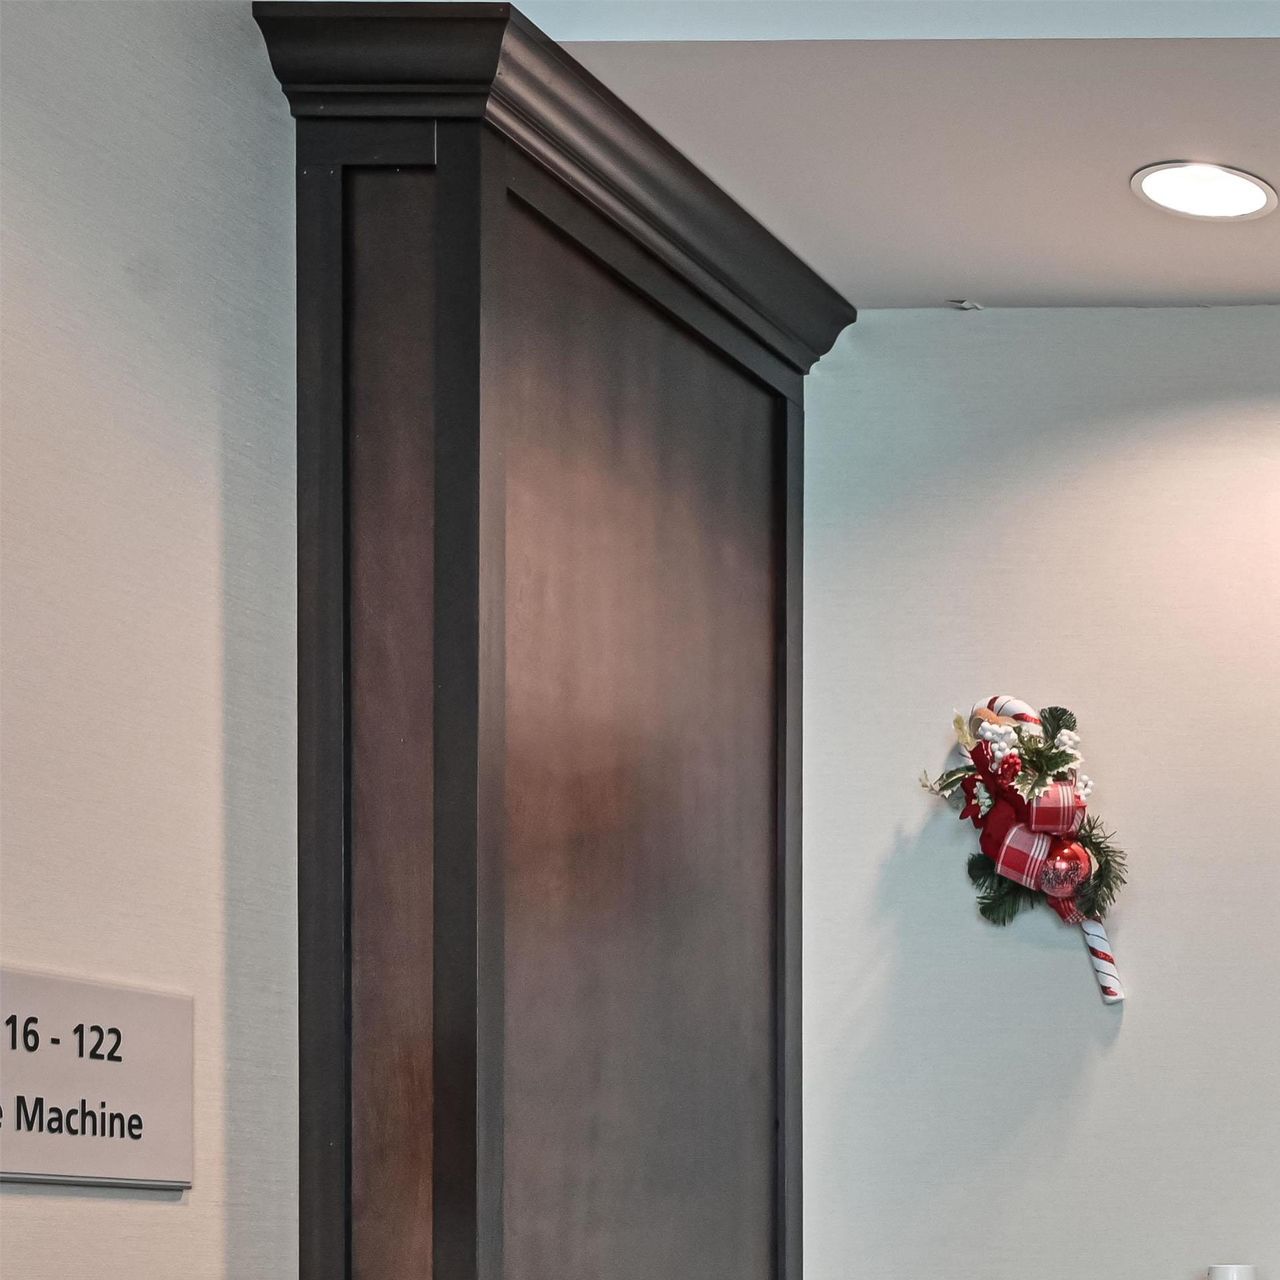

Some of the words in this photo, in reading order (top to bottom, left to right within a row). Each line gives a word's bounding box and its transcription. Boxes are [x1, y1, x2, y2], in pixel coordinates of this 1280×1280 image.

[50, 1037, 60, 1045] -
[73, 1023, 123, 1062] 122
[16, 1095, 143, 1140] Machine
